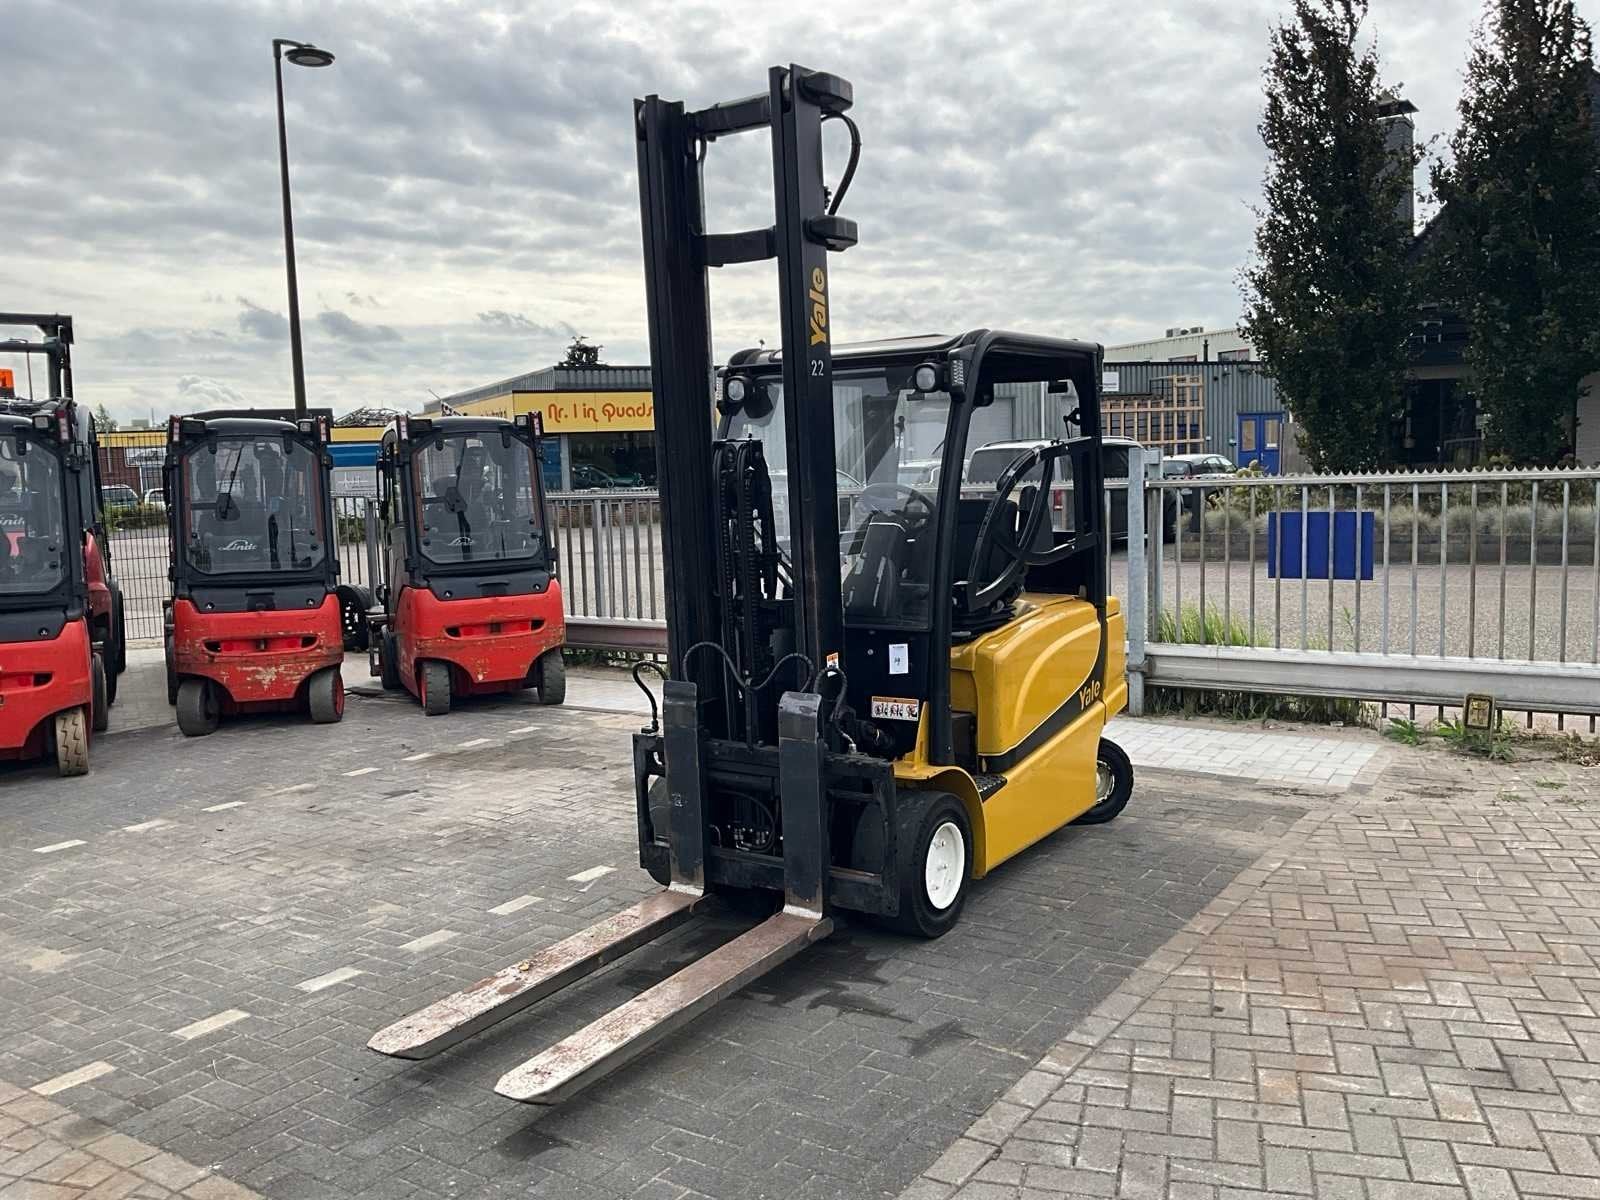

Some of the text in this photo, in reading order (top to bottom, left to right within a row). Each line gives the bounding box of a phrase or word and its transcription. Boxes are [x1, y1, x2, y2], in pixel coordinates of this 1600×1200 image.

[809, 267, 827, 346] Yale
[811, 359, 825, 376] 22
[548, 403, 569, 423] Nr.
[582, 403, 599, 422] in
[602, 402, 654, 422] Quads
[1079, 679, 1101, 711] Yale
